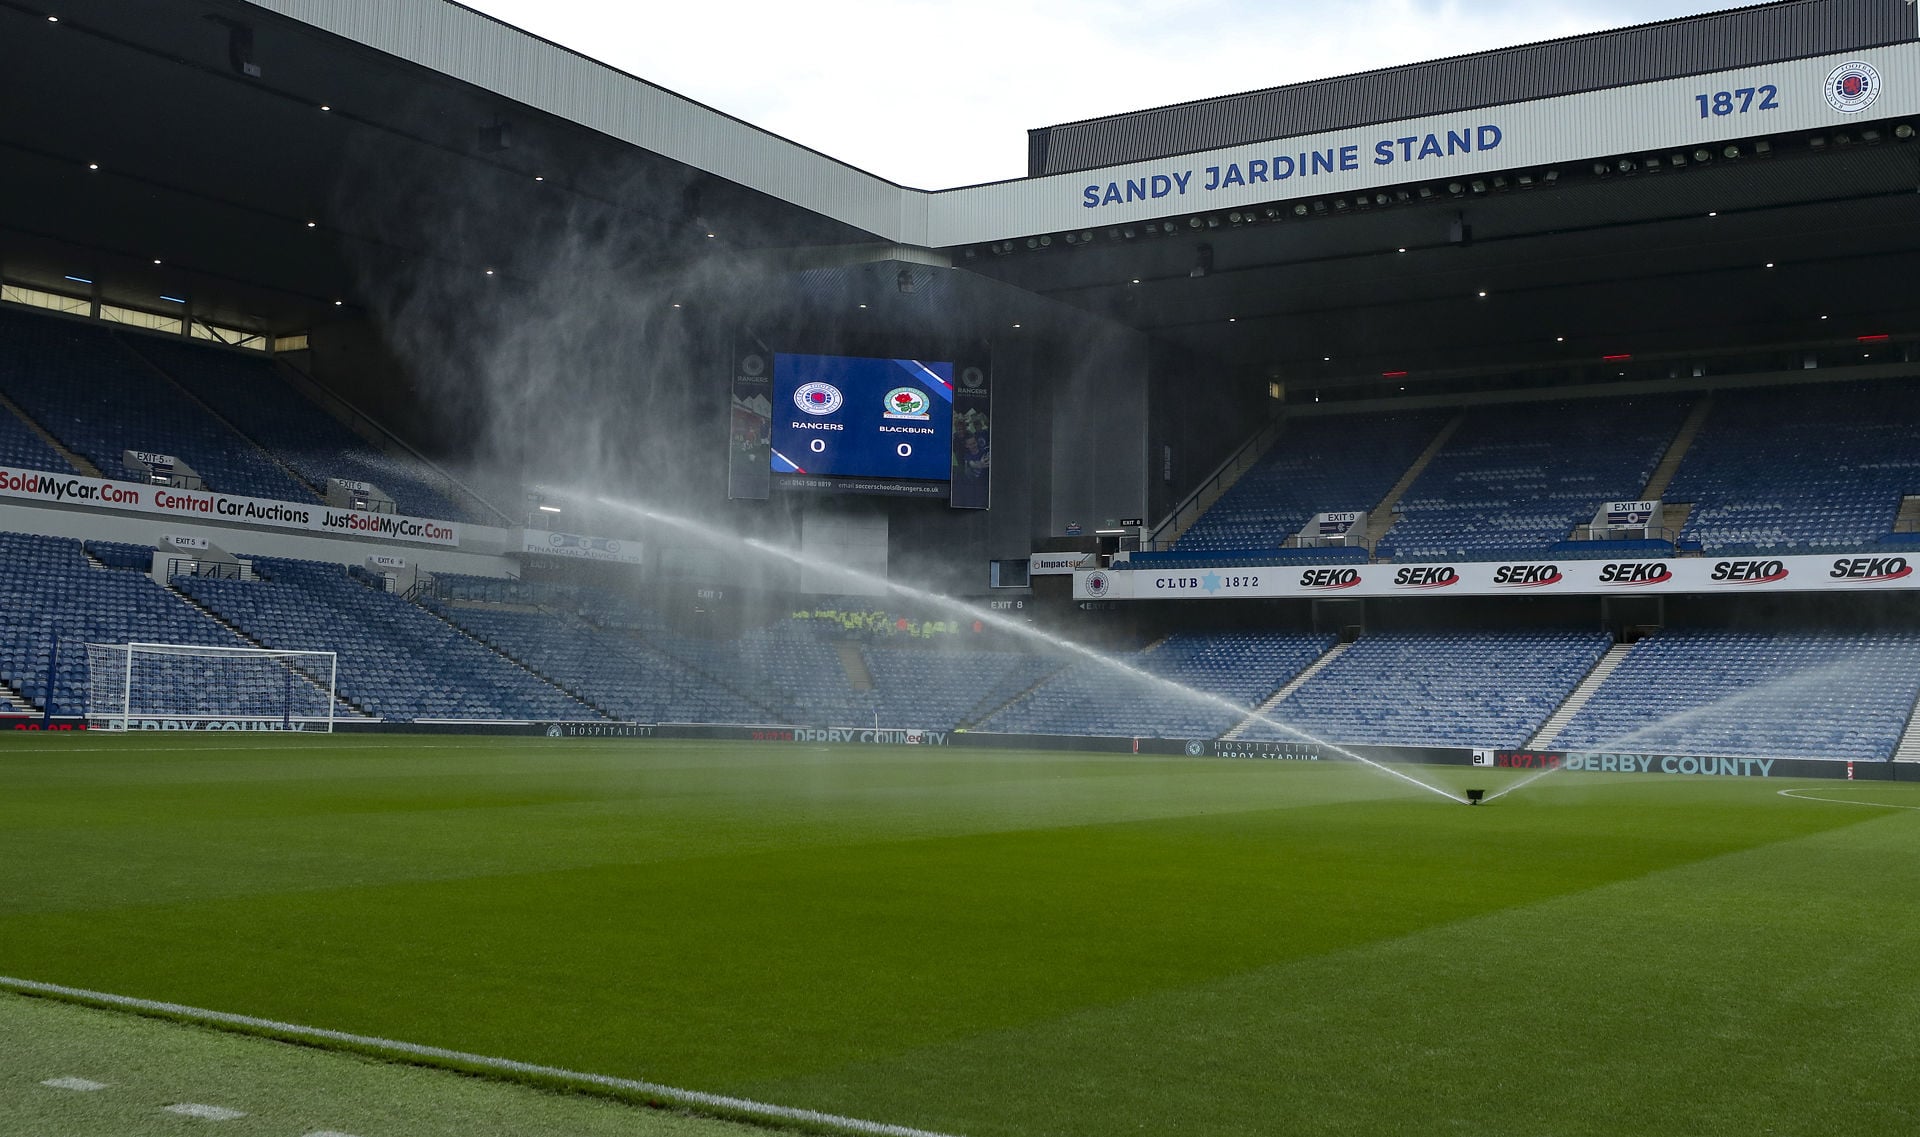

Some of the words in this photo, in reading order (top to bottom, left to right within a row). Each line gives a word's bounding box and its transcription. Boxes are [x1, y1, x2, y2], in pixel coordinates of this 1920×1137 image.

[1696, 85, 1778, 119] 1872
[1083, 171, 1192, 208] SANDY
[1204, 145, 1359, 191] JARDINE
[1374, 124, 1502, 165] STAND
[792, 421, 844, 431] RANGERS
[879, 426, 934, 435] BLACKBURN
[810, 439, 826, 453] 0
[896, 443, 912, 457] 0
[137, 452, 157, 462] EXIT
[159, 455, 165, 463] 5
[340, 480, 355, 489] EXIT
[1614, 503, 1637, 511] EXIT
[1640, 502, 1651, 511] 10
[155, 490, 214, 513] Central
[217, 499, 244, 516] Car
[245, 502, 309, 523] Auctions
[322, 511, 453, 540] JustSoldMyCar.Com
[1328, 513, 1347, 521] EXIT
[1349, 513, 1355, 521] 9
[176, 537, 190, 545] EXIT
[1493, 564, 1558, 584] SEKO
[1599, 562, 1668, 583] SEKO
[1711, 560, 1784, 580] SEKO
[1830, 557, 1908, 578] SEKO
[1156, 577, 1198, 589] CLUB
[1225, 576, 1259, 588] 1872
[1299, 568, 1358, 587] SEKO
[1393, 566, 1456, 585] SEKO
[991, 601, 1012, 610] EXIT
[1017, 600, 1023, 609] 8
[570, 727, 653, 736] HOSPITALITY
[794, 729, 855, 743] DERBY
[1214, 741, 1321, 754] HOSPITALITY
[1566, 752, 1652, 773] DERBY
[1661, 756, 1775, 778] COUNTY
